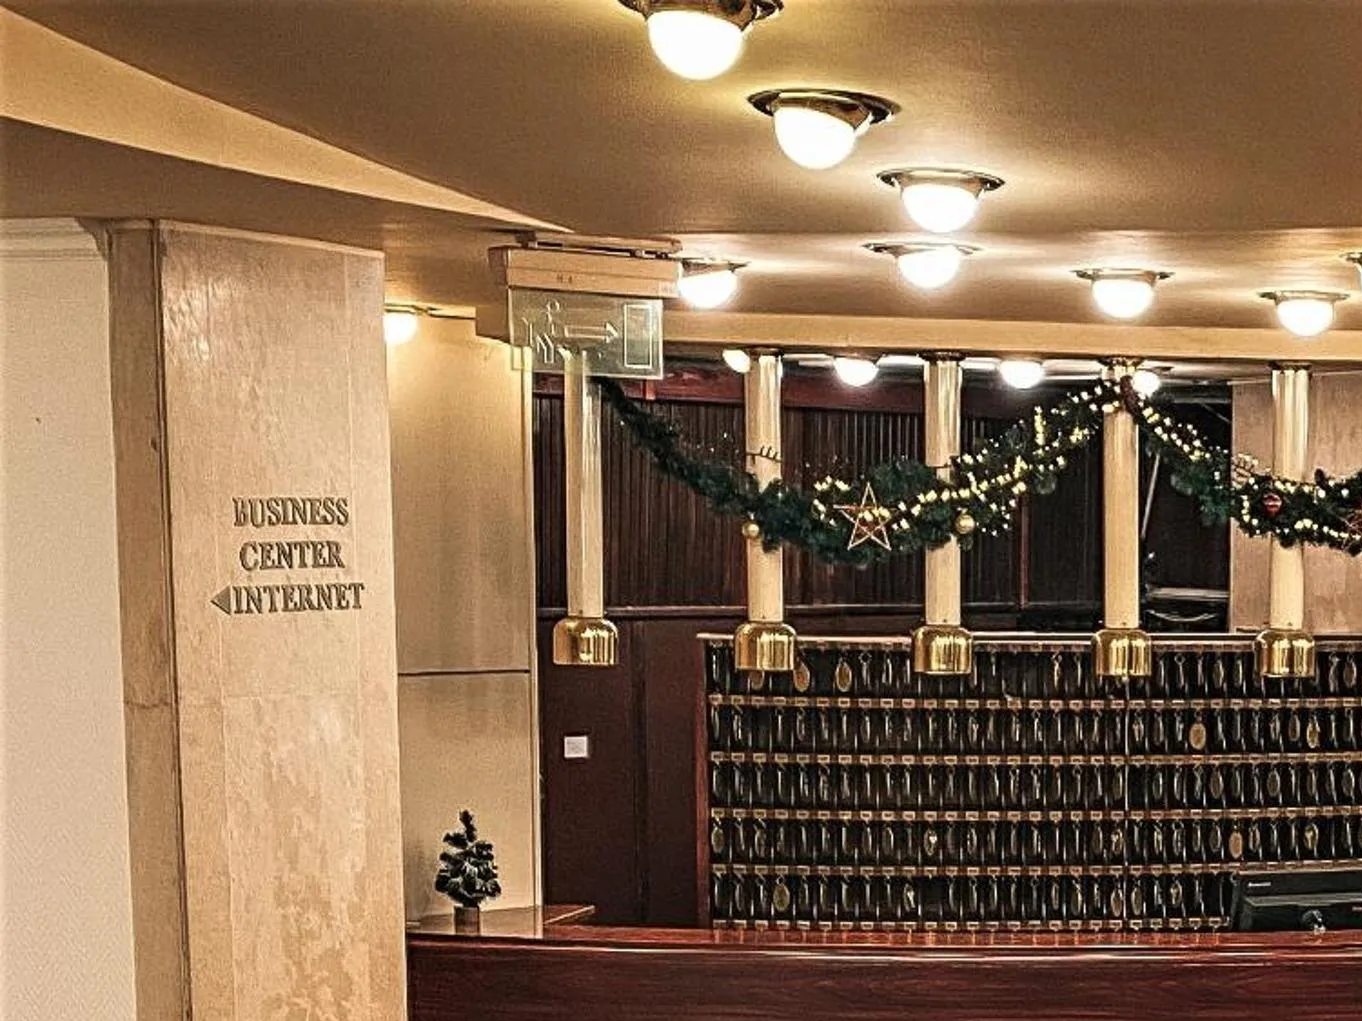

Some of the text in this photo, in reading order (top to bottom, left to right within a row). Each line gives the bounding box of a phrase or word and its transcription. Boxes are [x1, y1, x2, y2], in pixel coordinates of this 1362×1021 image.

[232, 496, 350, 528] BUSINESS
[239, 540, 346, 572] CENTER
[232, 582, 366, 615] INTERNET
